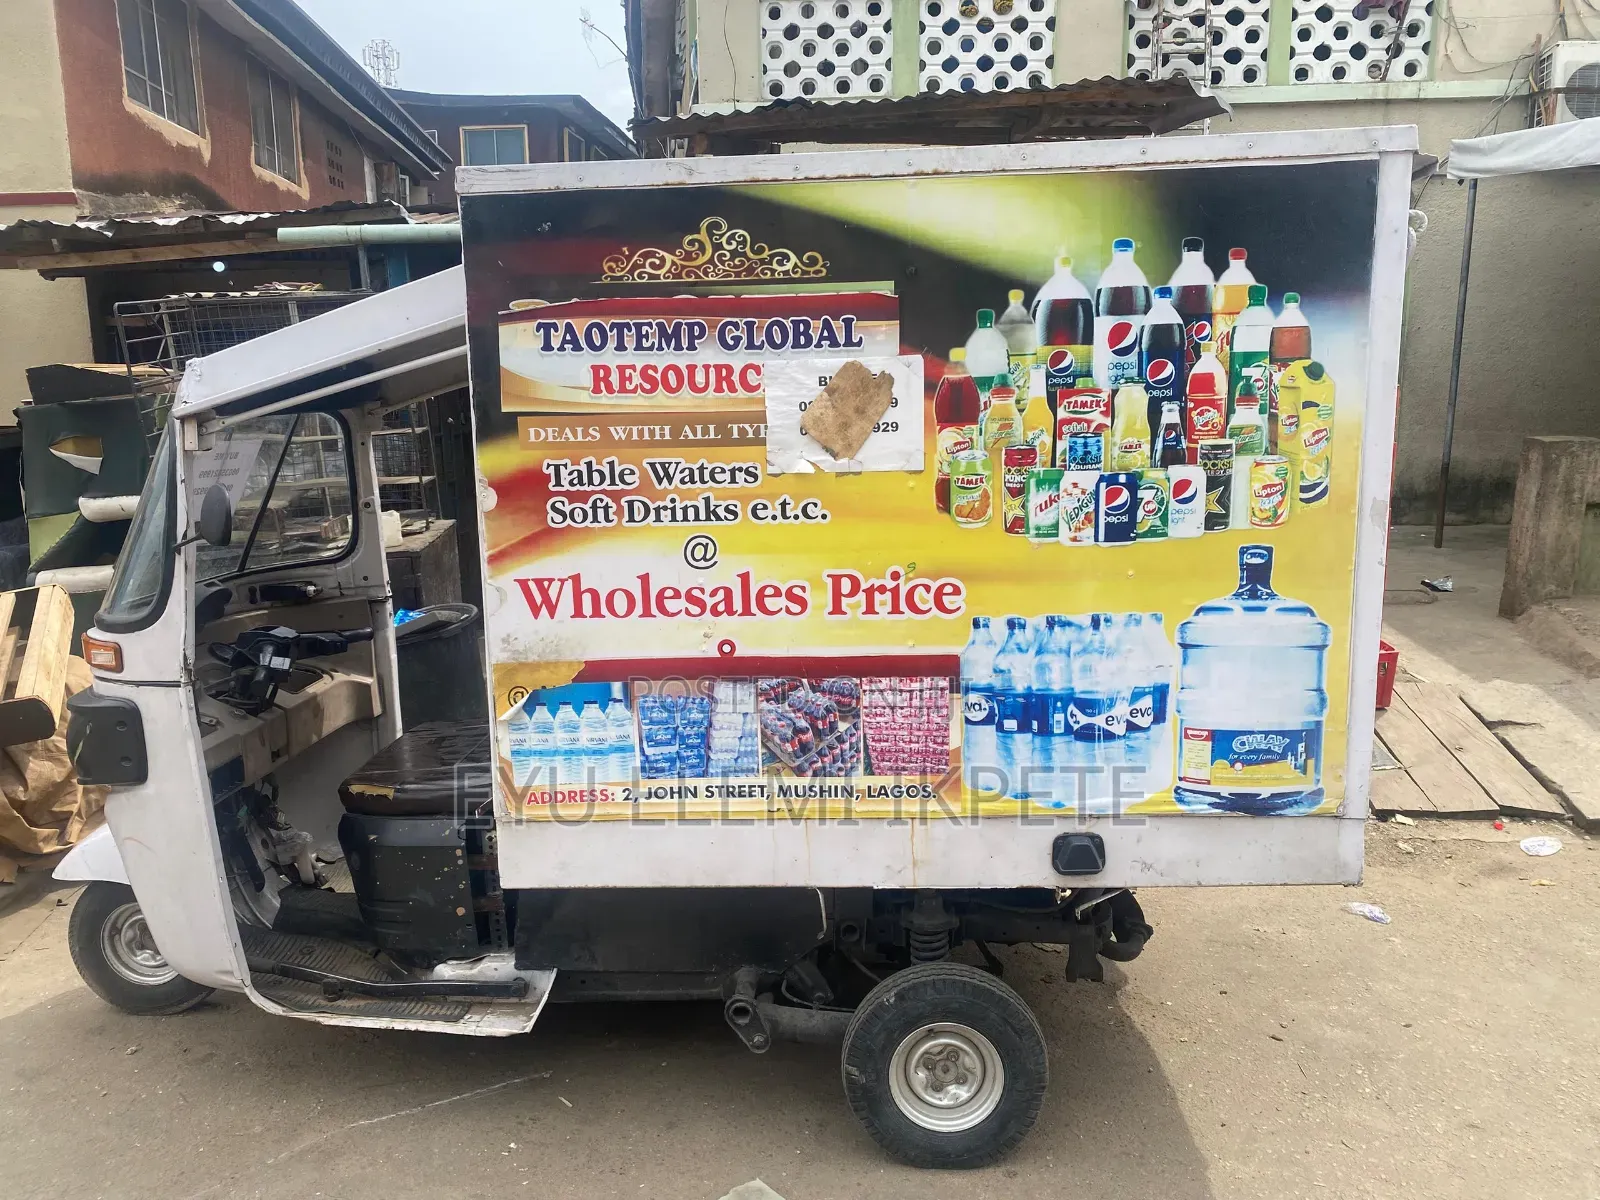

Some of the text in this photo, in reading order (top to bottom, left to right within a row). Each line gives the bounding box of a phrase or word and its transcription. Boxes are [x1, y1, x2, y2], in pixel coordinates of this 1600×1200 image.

[535, 315, 863, 353] TAOTEMP GLOBAL
[1108, 359, 1137, 373] pepsi
[589, 362, 766, 396] RESOURC
[1048, 375, 1074, 386] pepsi
[1147, 387, 1174, 398] pepsi
[1065, 398, 1102, 411] TAMEK
[527, 426, 601, 443] DEALS
[611, 425, 673, 442] WITH
[678, 424, 722, 440] ALL
[1305, 430, 1328, 445] Lipton
[946, 440, 970, 454] Lipton
[545, 460, 760, 489] Table Waters
[955, 474, 987, 487] TAMEK
[1004, 474, 1028, 482] PUNC
[1253, 484, 1284, 498] Lipton
[548, 494, 830, 526] Soft Drinks e.t.c.
[1170, 507, 1197, 517] pepsi
[1104, 513, 1129, 524] pepsi
[683, 535, 720, 571] @
[513, 569, 964, 621] Wholesales Price
[1227, 753, 1239, 761] for
[1258, 752, 1281, 761] family
[526, 783, 938, 806] ADDRESS: 2, JOHN STREET, MUSHIN, LAGOS.
